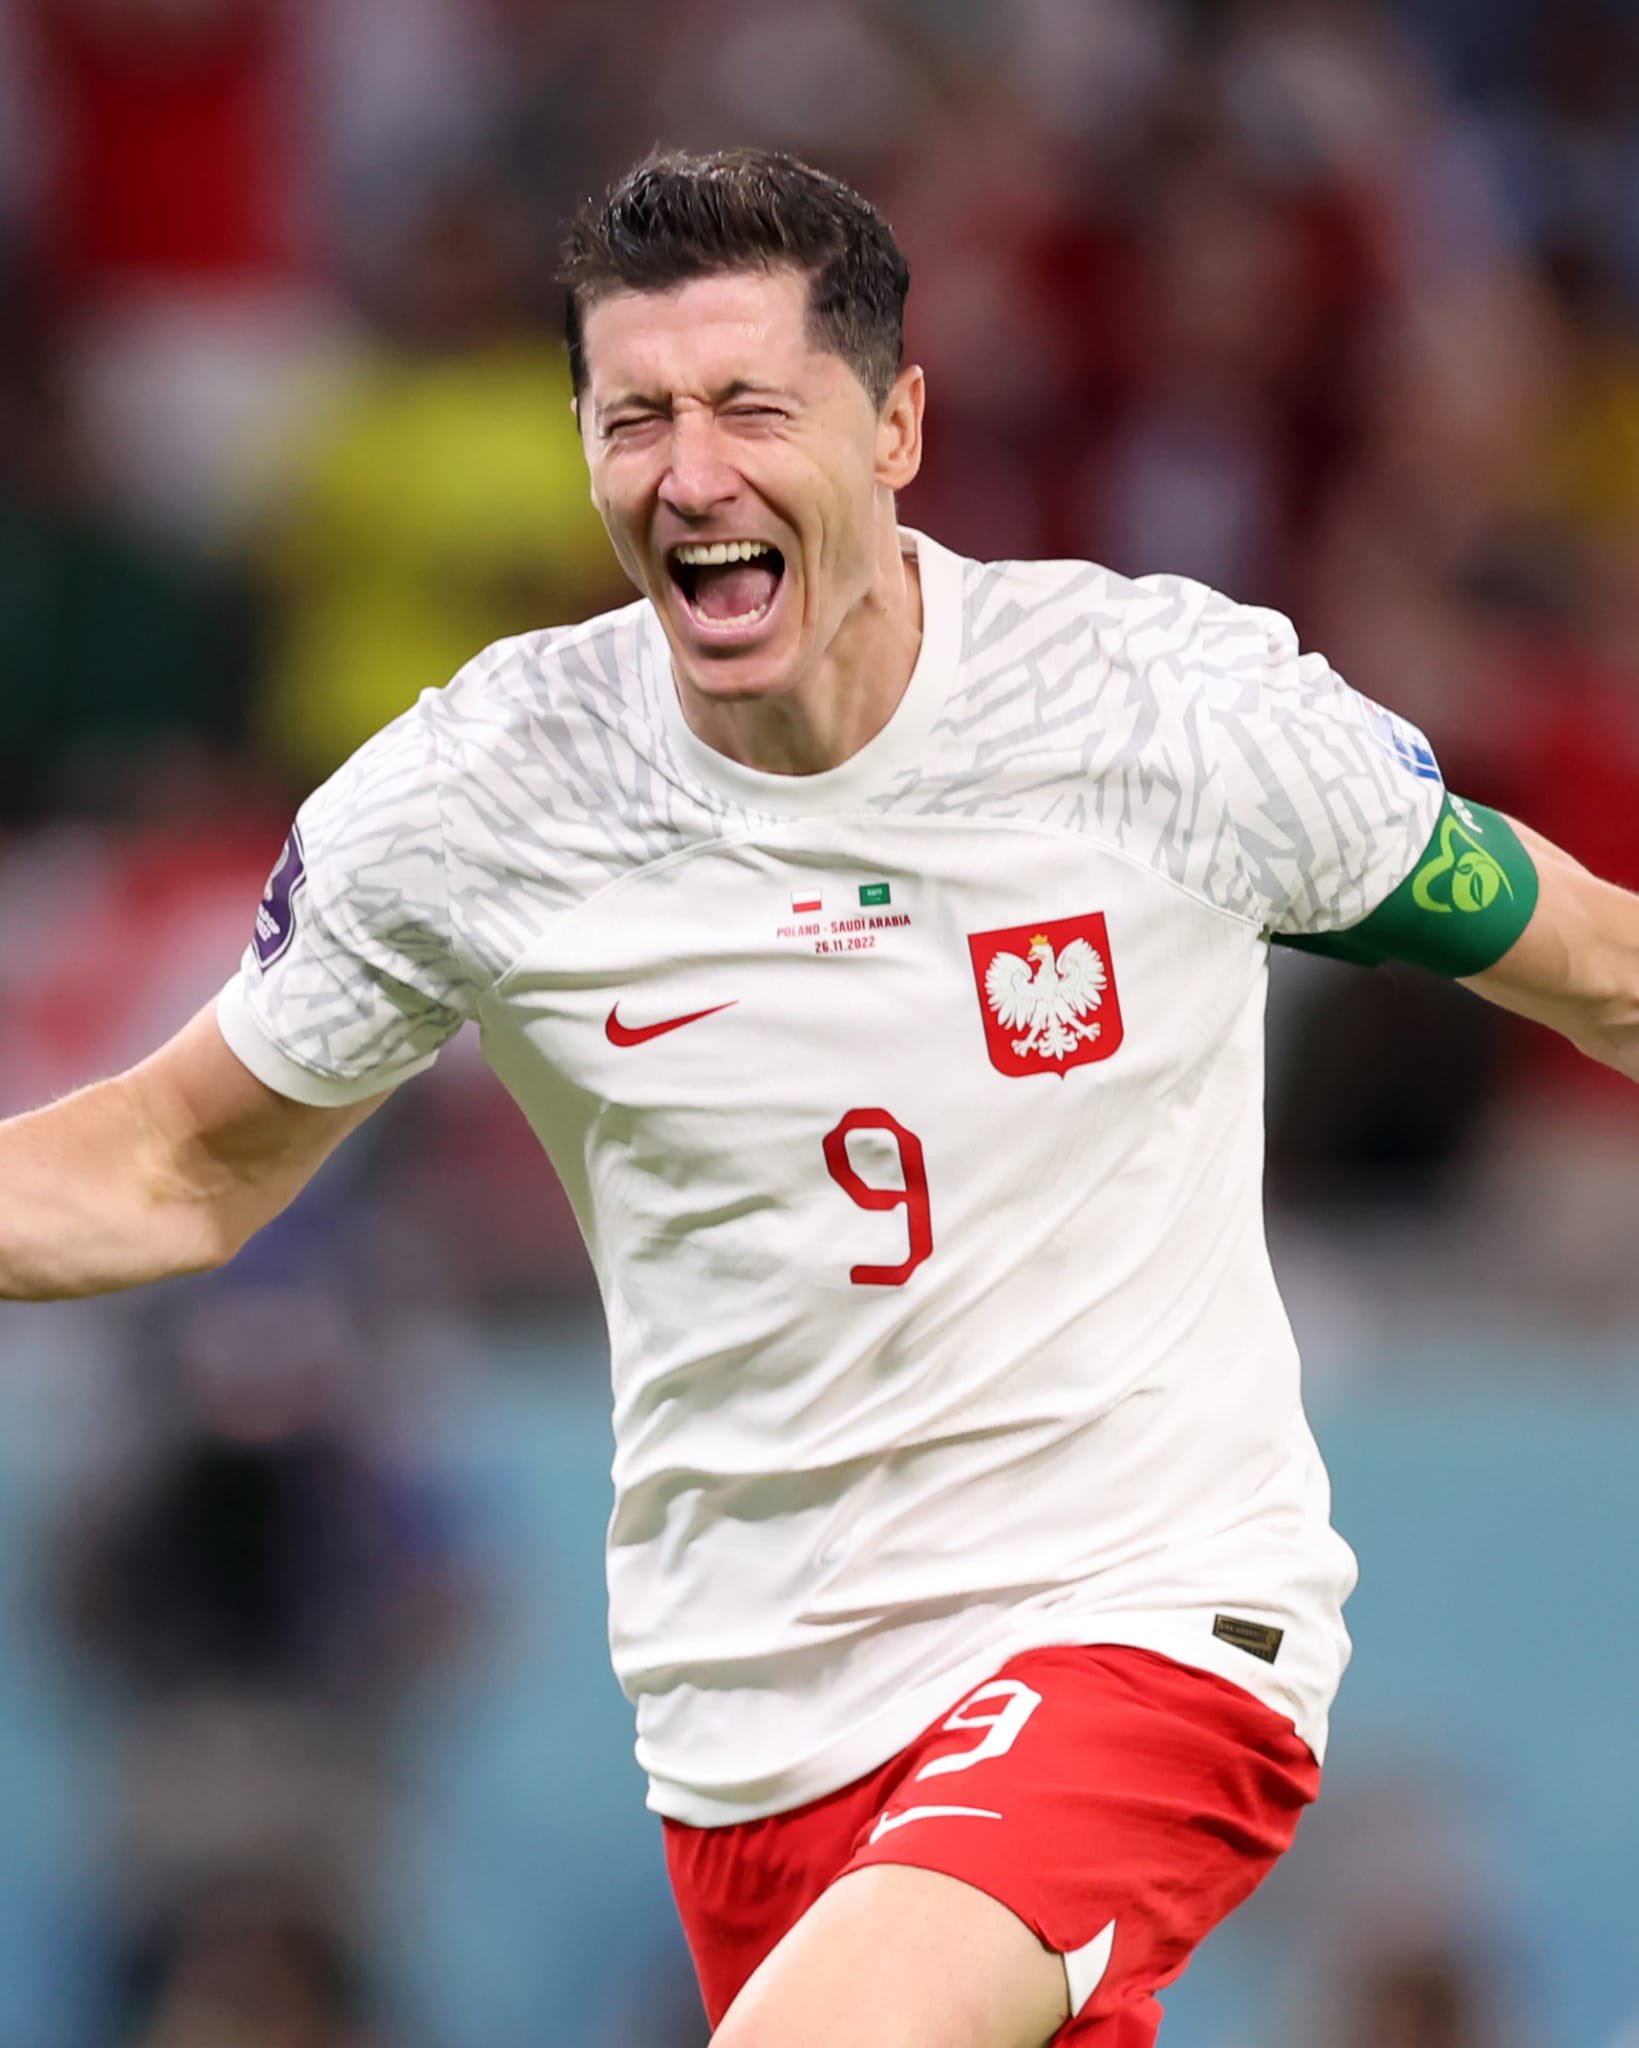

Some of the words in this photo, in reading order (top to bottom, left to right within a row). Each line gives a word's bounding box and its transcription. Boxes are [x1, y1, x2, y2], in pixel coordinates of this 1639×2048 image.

[777, 923, 820, 938] POLAND
[830, 917, 866, 934] SAUDI
[869, 914, 911, 929] ARABIA
[814, 936, 876, 954] 26.11.2022
[822, 1107, 934, 1286] 9
[915, 1679, 1043, 1782] 9
